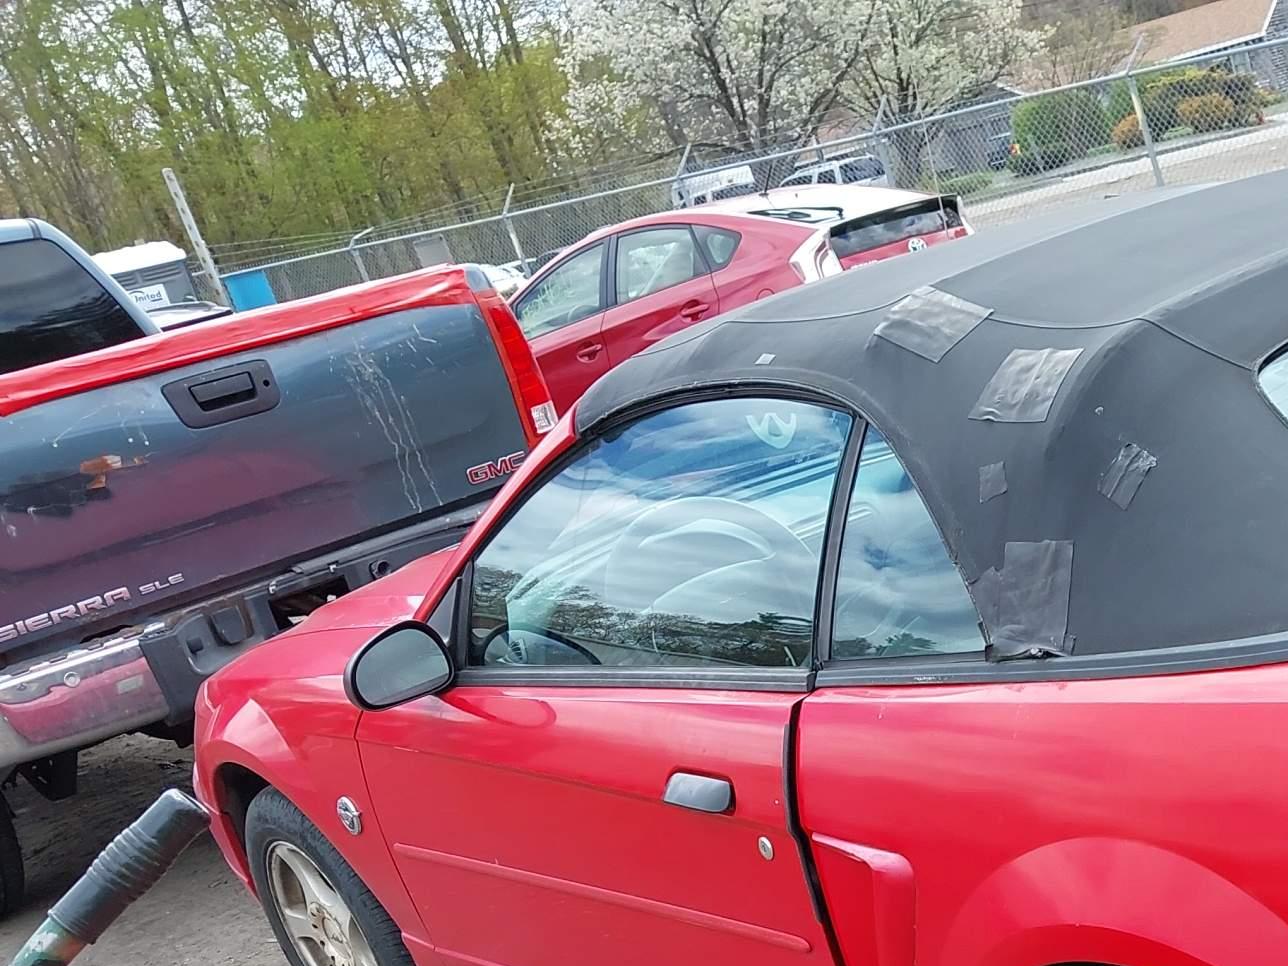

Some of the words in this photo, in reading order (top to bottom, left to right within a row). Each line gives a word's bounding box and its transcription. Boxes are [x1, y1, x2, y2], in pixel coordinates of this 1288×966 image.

[466, 450, 526, 485] GMC
[0, 586, 132, 643] SIERRA
[138, 572, 186, 596] SLE
